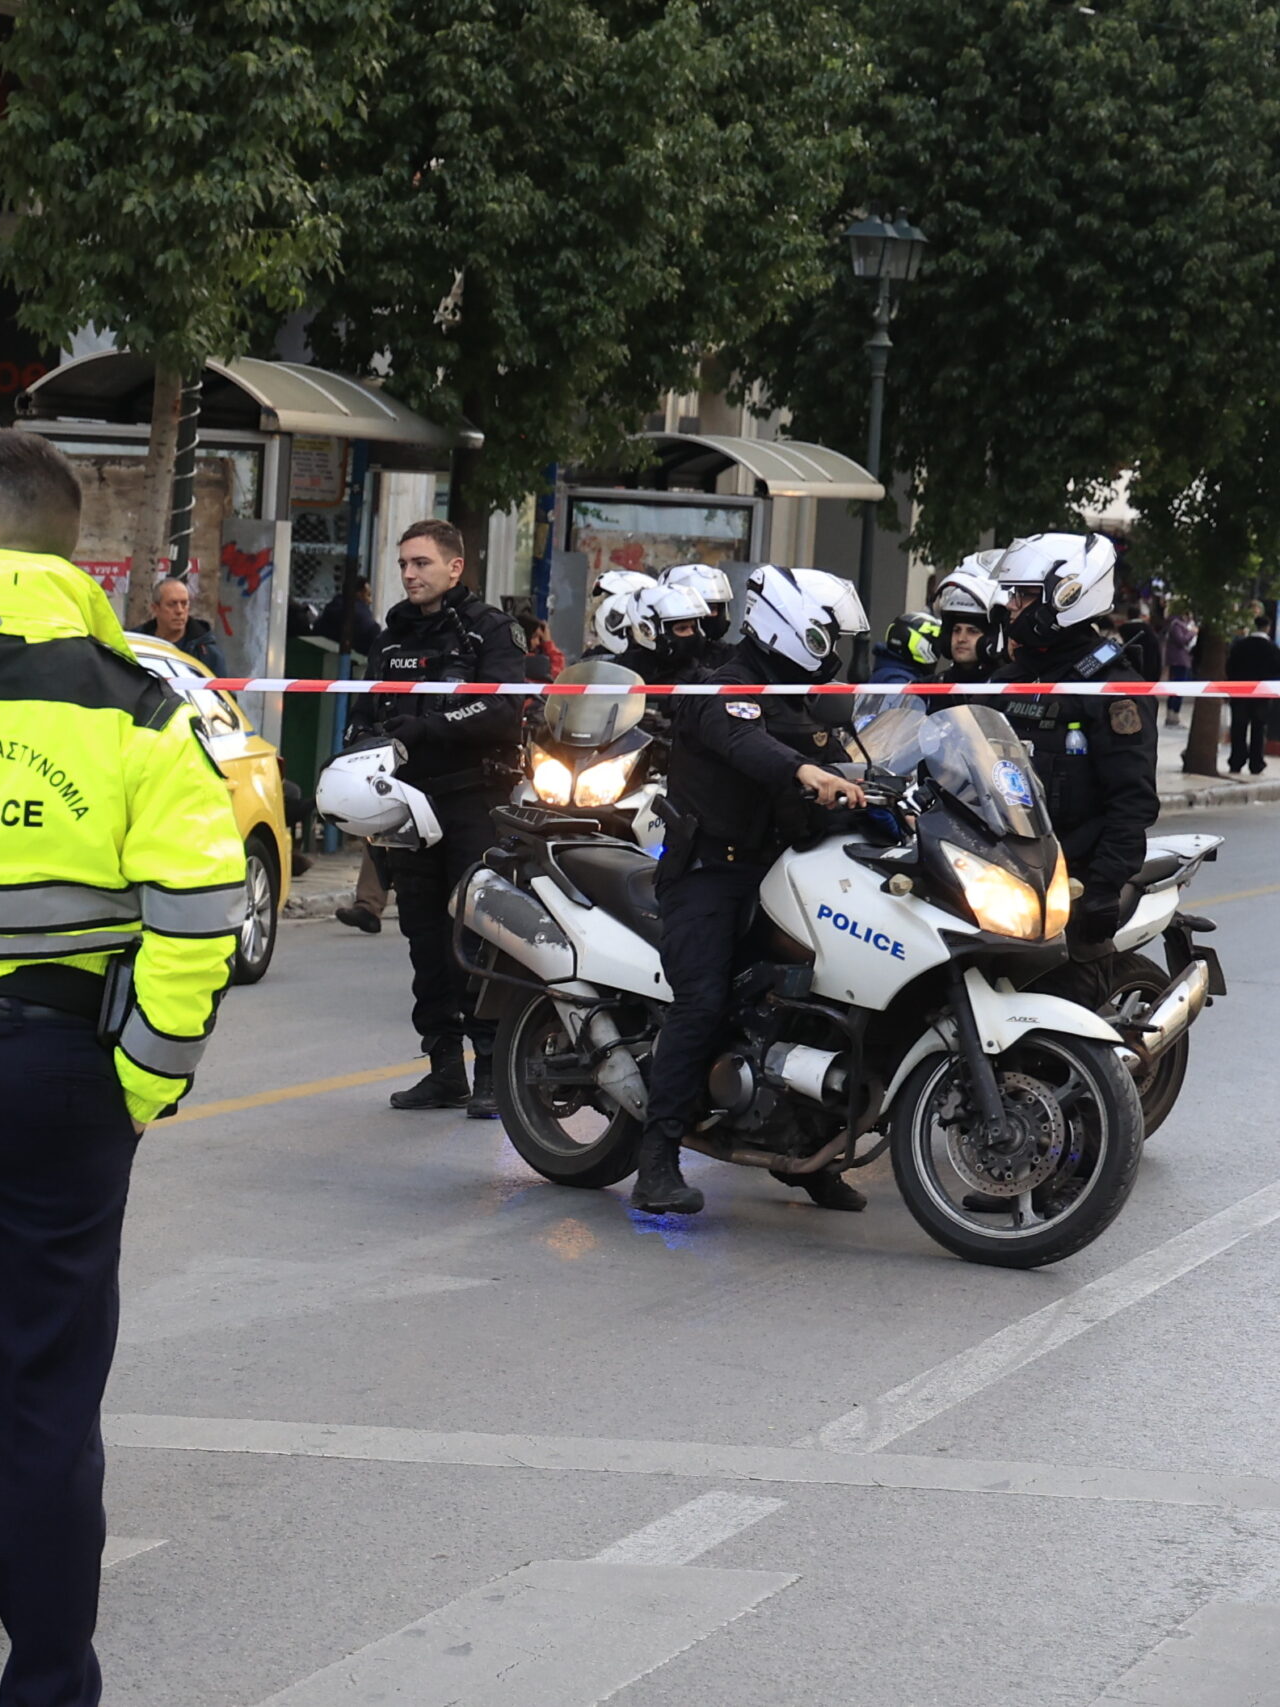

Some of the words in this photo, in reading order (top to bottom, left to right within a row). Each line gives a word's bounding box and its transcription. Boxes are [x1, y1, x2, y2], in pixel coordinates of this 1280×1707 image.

[389, 657, 418, 669] POLICE
[444, 701, 487, 722] POLICE
[1006, 701, 1045, 718] POLICE
[817, 904, 906, 961] POLICE
